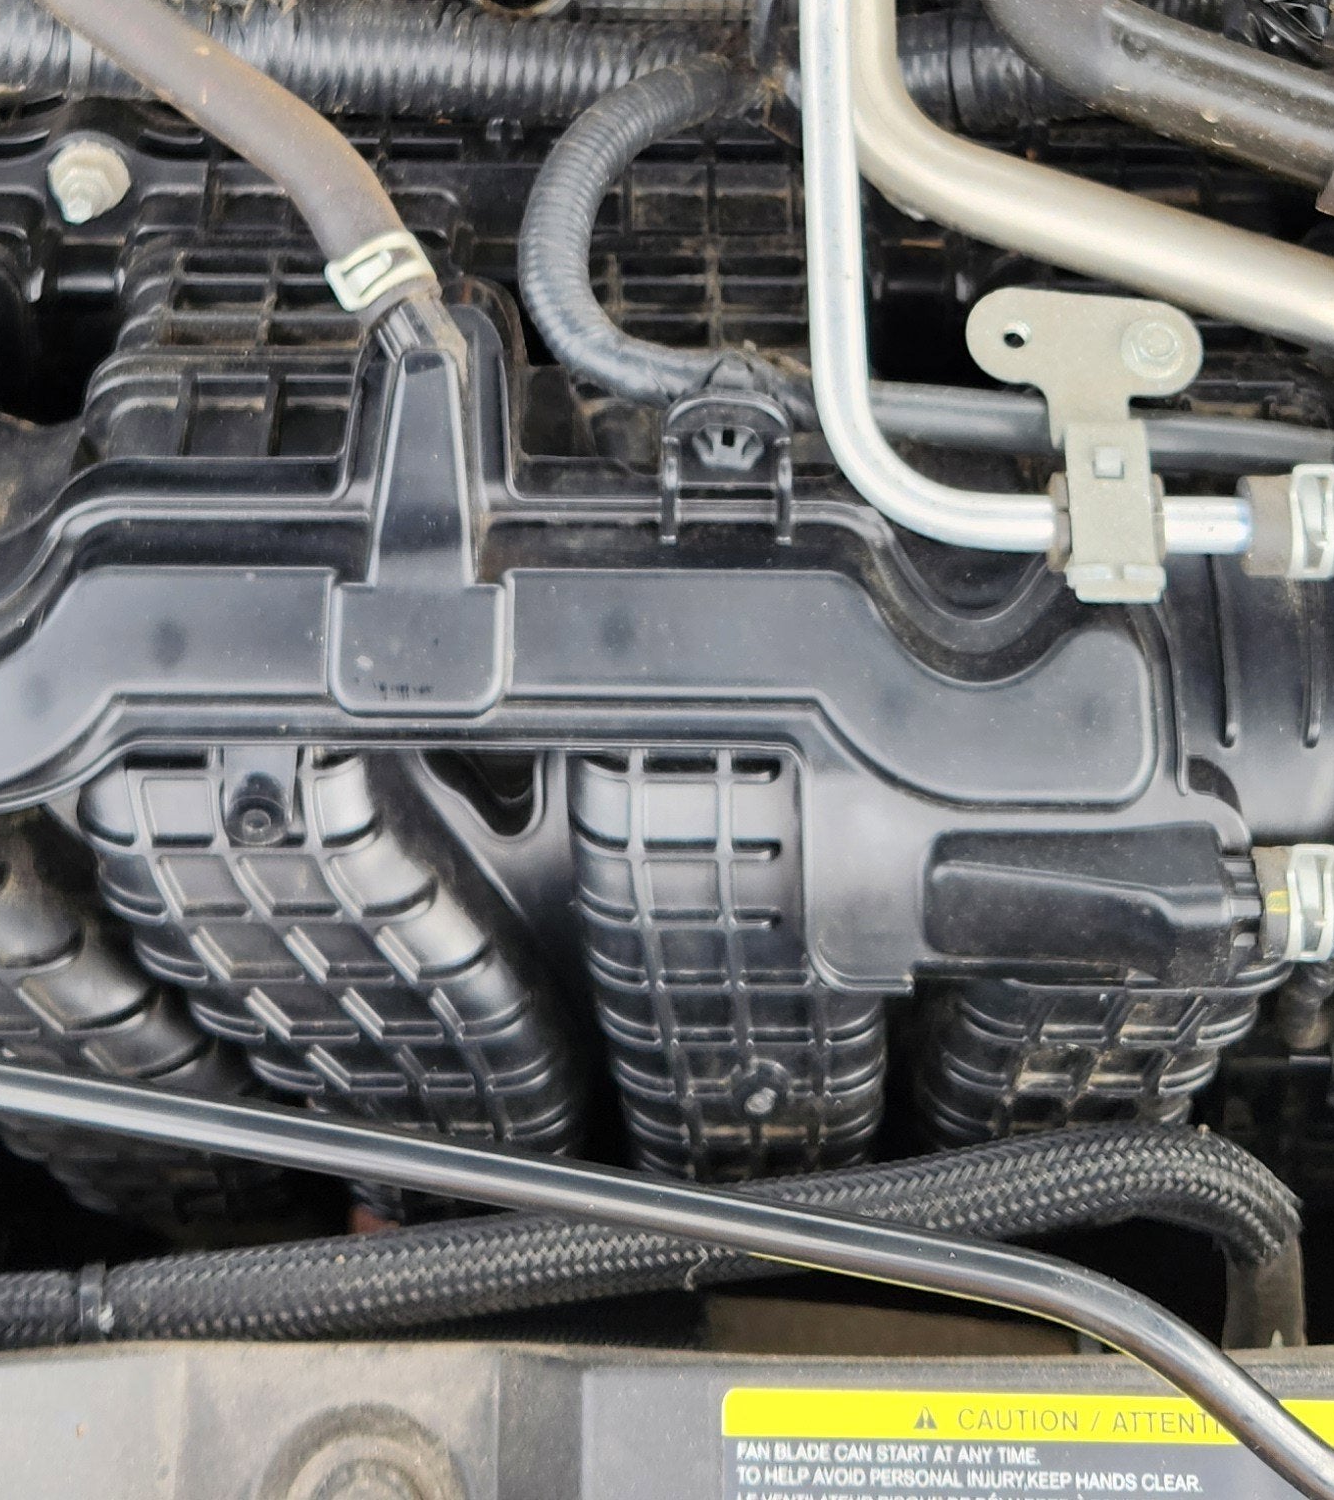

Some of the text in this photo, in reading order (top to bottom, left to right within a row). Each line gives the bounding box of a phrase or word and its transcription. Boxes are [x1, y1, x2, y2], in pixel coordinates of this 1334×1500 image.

[957, 1408, 1079, 1432] CAUTION
[1090, 1411, 1101, 1432] /
[736, 1441, 1041, 1466] FAN BLADE CAN START AT ANY TIME.
[736, 1466, 762, 1485] TO
[764, 1466, 811, 1486] HELP
[812, 1467, 867, 1487] AVOID
[869, 1468, 964, 1488] PERSONAL
[1075, 1471, 1138, 1492] HANDS
[1141, 1473, 1203, 1493] CLEAR.
